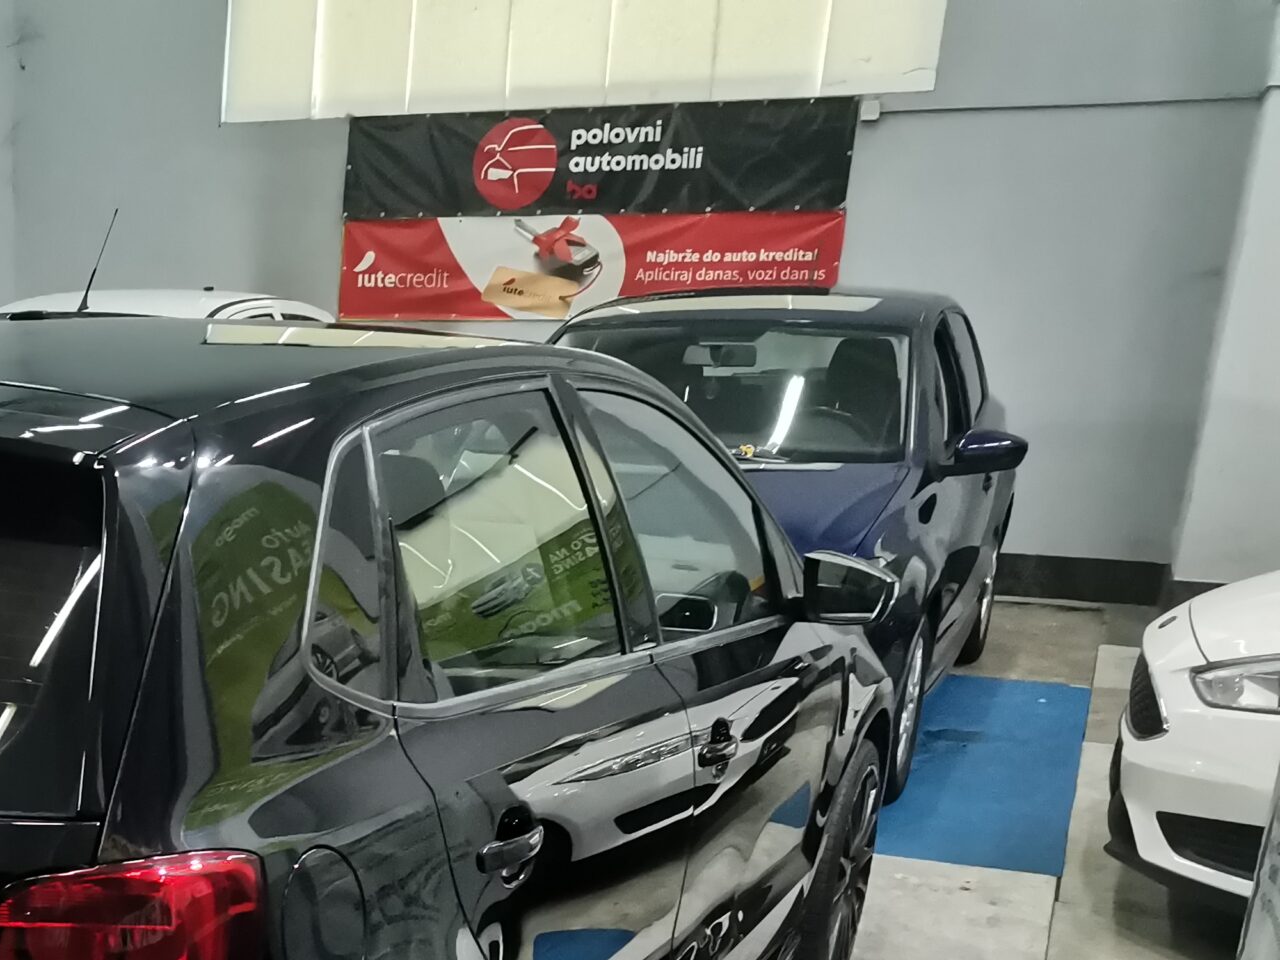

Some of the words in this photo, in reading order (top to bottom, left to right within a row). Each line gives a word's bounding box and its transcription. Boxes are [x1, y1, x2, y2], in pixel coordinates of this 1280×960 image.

[570, 119, 663, 151] polovni
[568, 146, 704, 173] automobili
[646, 249, 699, 265] Najbrže
[702, 250, 721, 263] do
[723, 250, 757, 263] auto
[354, 257, 450, 289] iutecredit
[634, 268, 692, 285] Apliciraj
[695, 267, 744, 283] danas,
[747, 266, 777, 281] vozi
